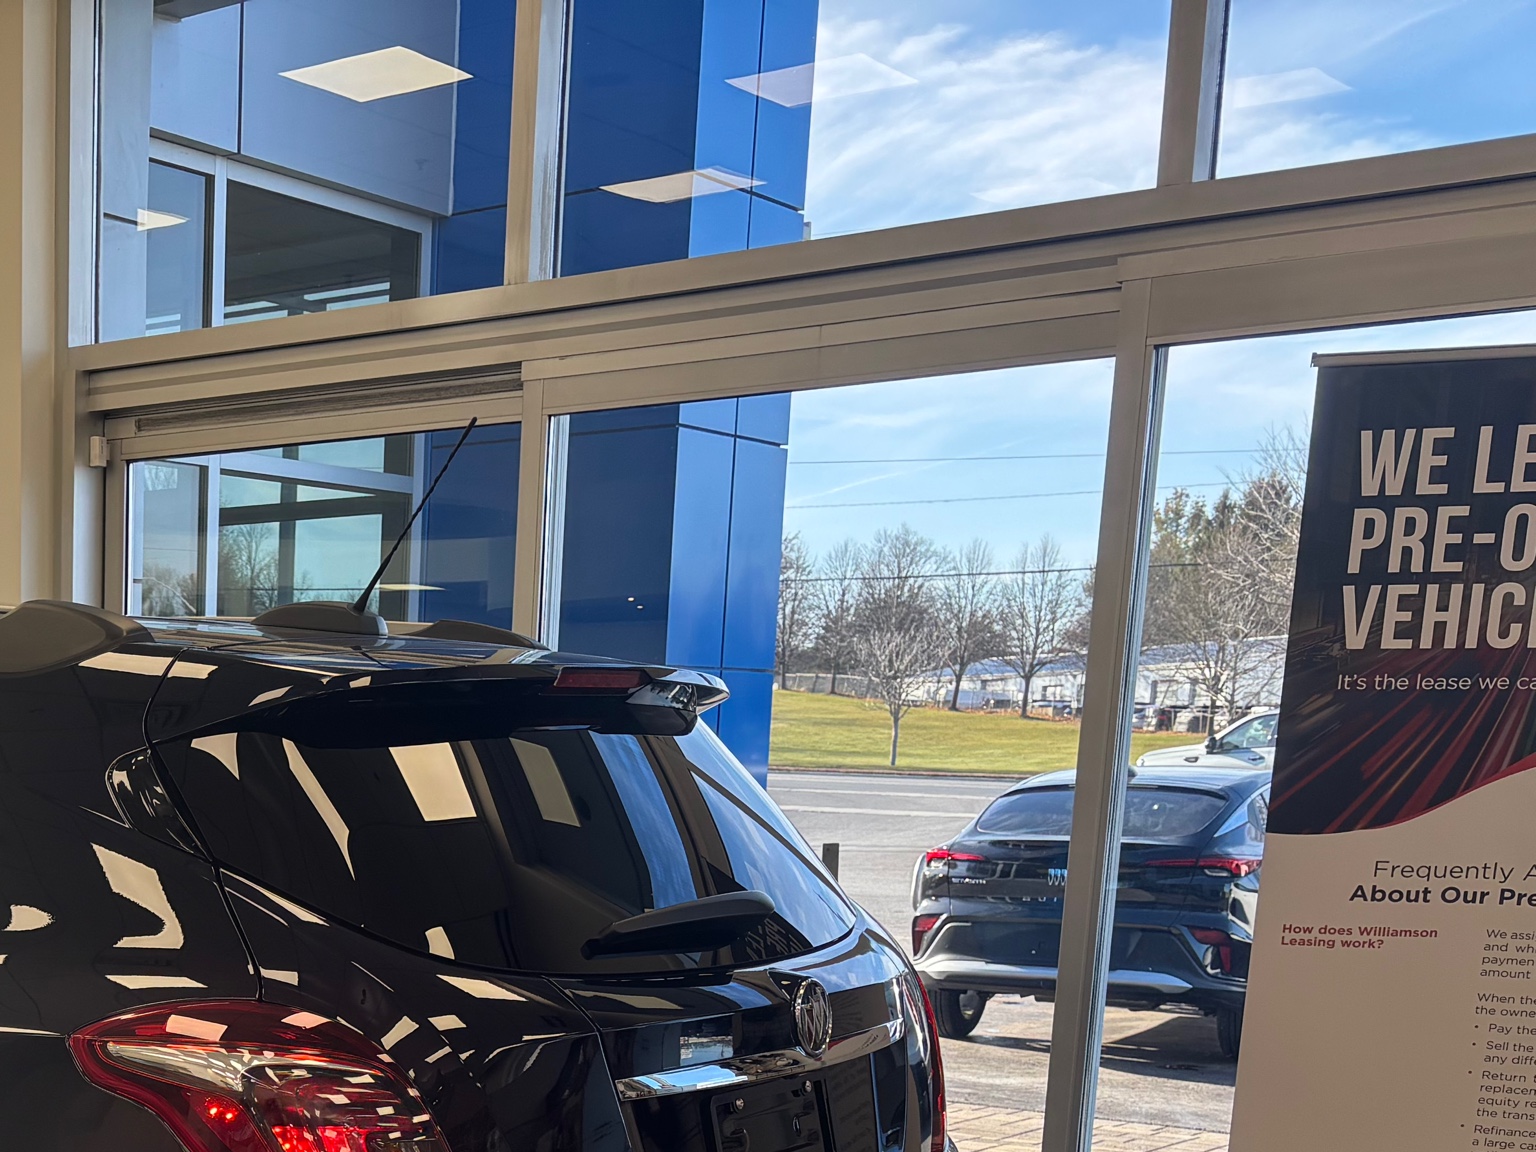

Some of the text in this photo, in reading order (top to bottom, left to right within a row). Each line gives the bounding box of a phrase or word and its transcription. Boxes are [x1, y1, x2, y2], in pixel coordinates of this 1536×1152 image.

[1360, 424, 1536, 497] WE LE
[1347, 503, 1536, 574] PRE-O
[1342, 582, 1536, 650] VEHIC
[1337, 674, 1367, 690] It's
[1374, 673, 1409, 690] the
[1416, 673, 1471, 690] lease
[1479, 677, 1509, 690] we
[1373, 860, 1514, 884] Frequently
[1349, 884, 1431, 903] About
[1440, 886, 1490, 904] Our
[1282, 924, 1438, 938] How does Williamson
[1486, 929, 1507, 939] We
[1281, 936, 1384, 949] Leasing work?
[1484, 943, 1536, 954] and wh
[1480, 969, 1531, 979] amount
[1477, 992, 1515, 1004] When
[1475, 1005, 1496, 1016] the
[1488, 1023, 1512, 1035] Pay
[1486, 1040, 1534, 1053] Sell the
[1484, 1054, 1536, 1065] any diff
[1482, 1070, 1526, 1082] Return
[1478, 1097, 1520, 1108] equity
[1476, 1108, 1535, 1121] the trans
[1474, 1124, 1536, 1138] Refinance
[1472, 1138, 1536, 1151] a large ca
